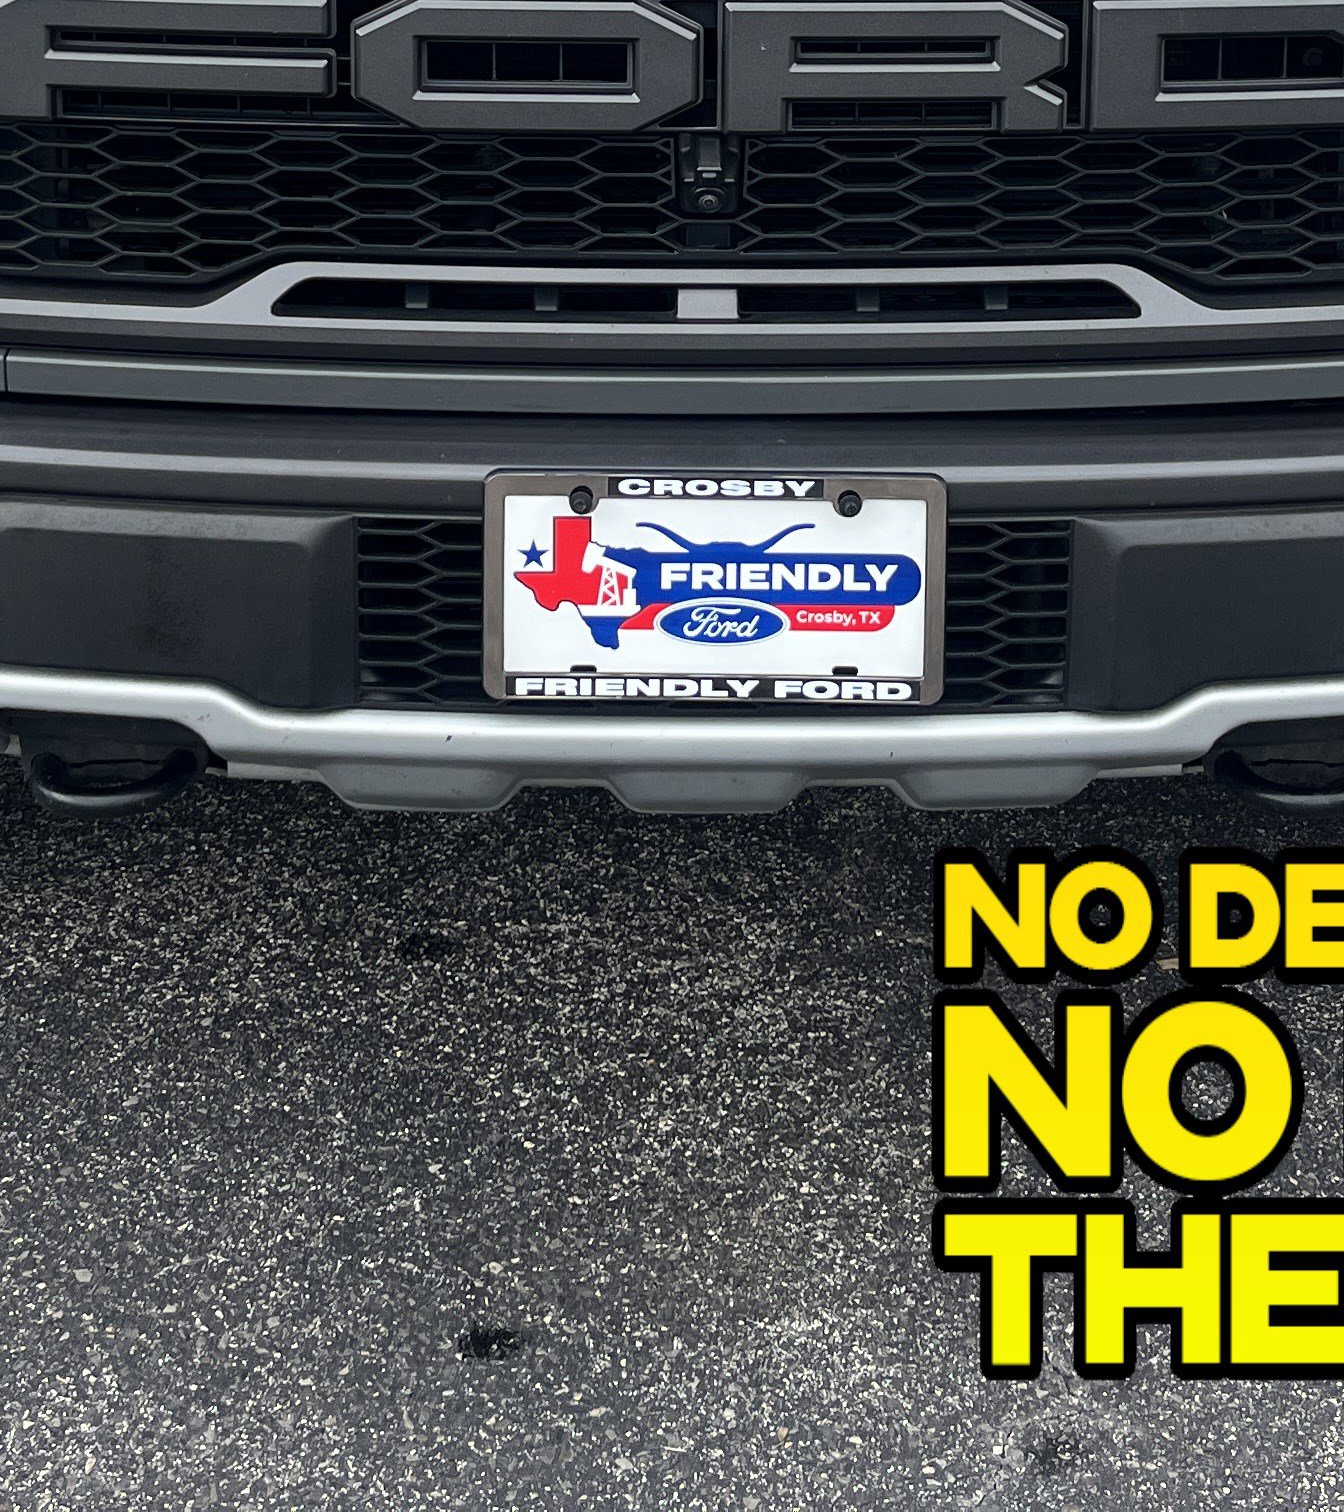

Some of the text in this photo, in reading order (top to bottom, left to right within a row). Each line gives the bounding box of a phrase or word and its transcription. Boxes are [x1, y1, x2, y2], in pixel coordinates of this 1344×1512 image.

[617, 477, 816, 498] CROSBY
[660, 562, 899, 592] FRIENDLY
[682, 606, 761, 638] Ford
[795, 609, 882, 627] Crosby, TX
[515, 677, 913, 701] FRIENDLY FORD
